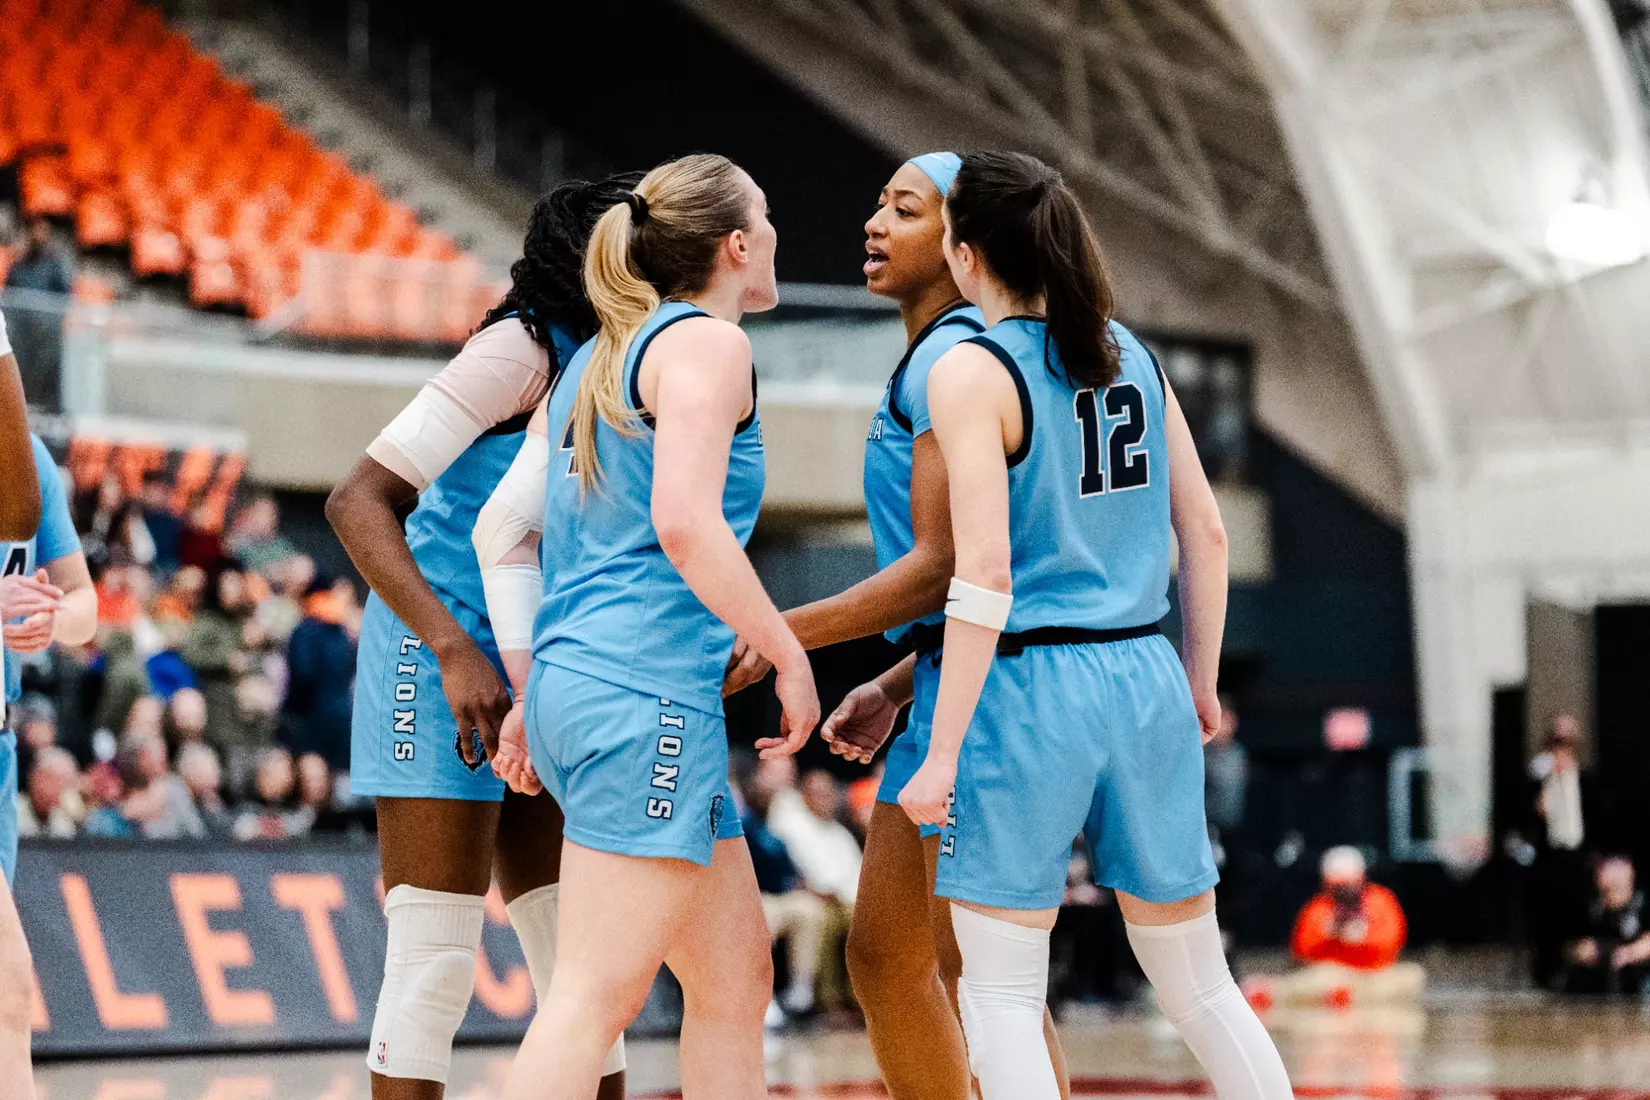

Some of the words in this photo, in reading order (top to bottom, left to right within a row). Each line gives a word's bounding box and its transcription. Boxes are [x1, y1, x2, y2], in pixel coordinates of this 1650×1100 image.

[1073, 381, 1150, 499] 12
[393, 635, 423, 761] LIONS
[646, 697, 685, 820] IONS
